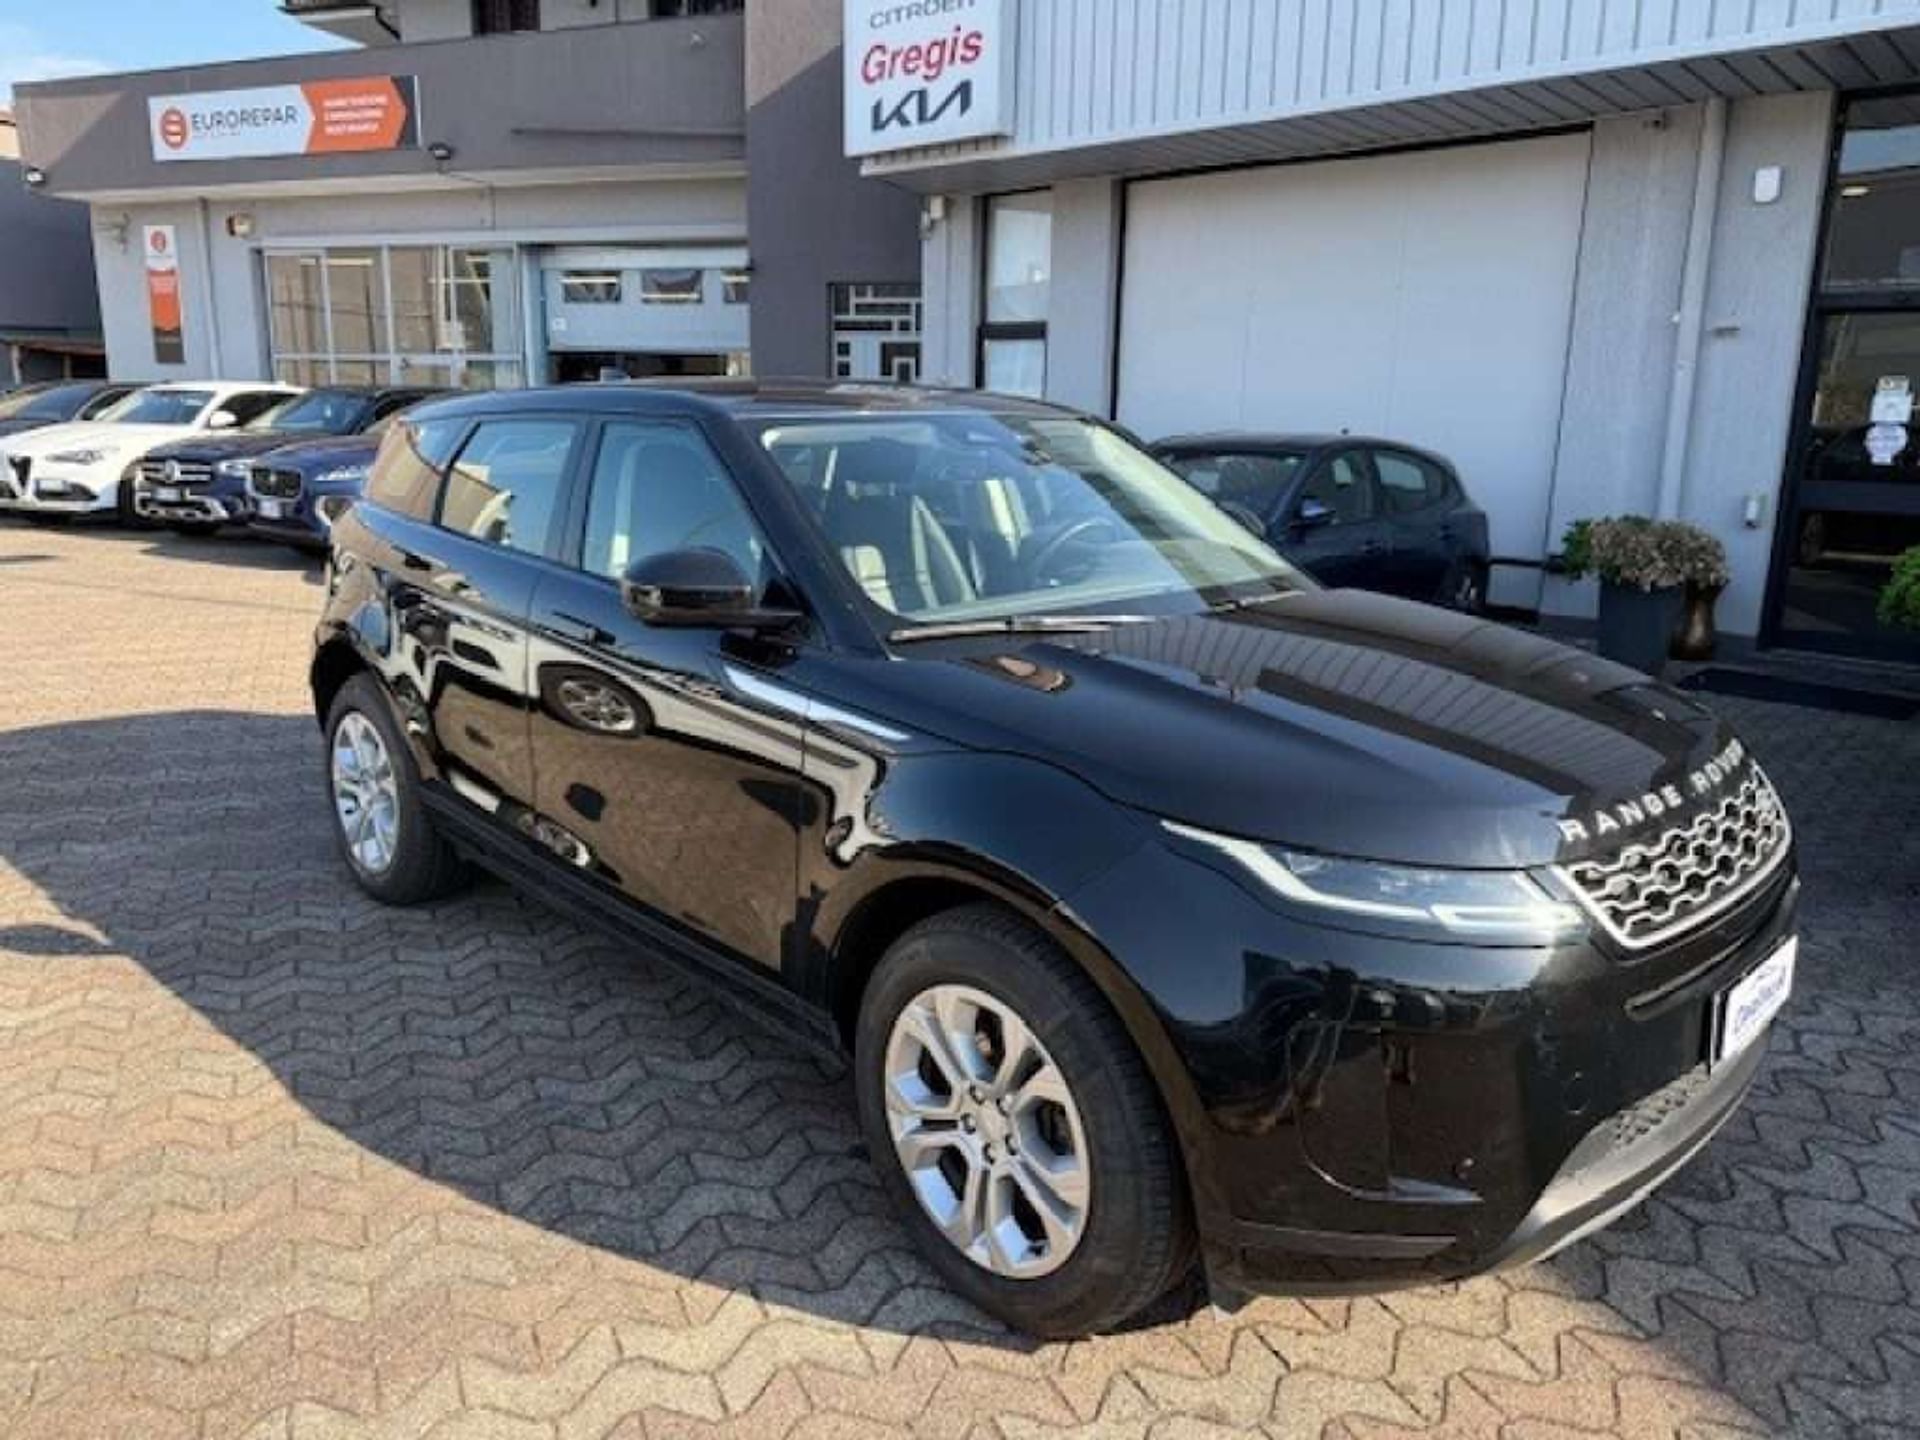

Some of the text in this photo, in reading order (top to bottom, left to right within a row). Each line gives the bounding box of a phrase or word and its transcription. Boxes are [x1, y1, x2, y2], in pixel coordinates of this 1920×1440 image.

[861, 24, 983, 84] Gregis
[191, 104, 298, 131] EUROREPAR
[871, 79, 973, 133] KIA
[1557, 784, 1682, 842] RANGE
